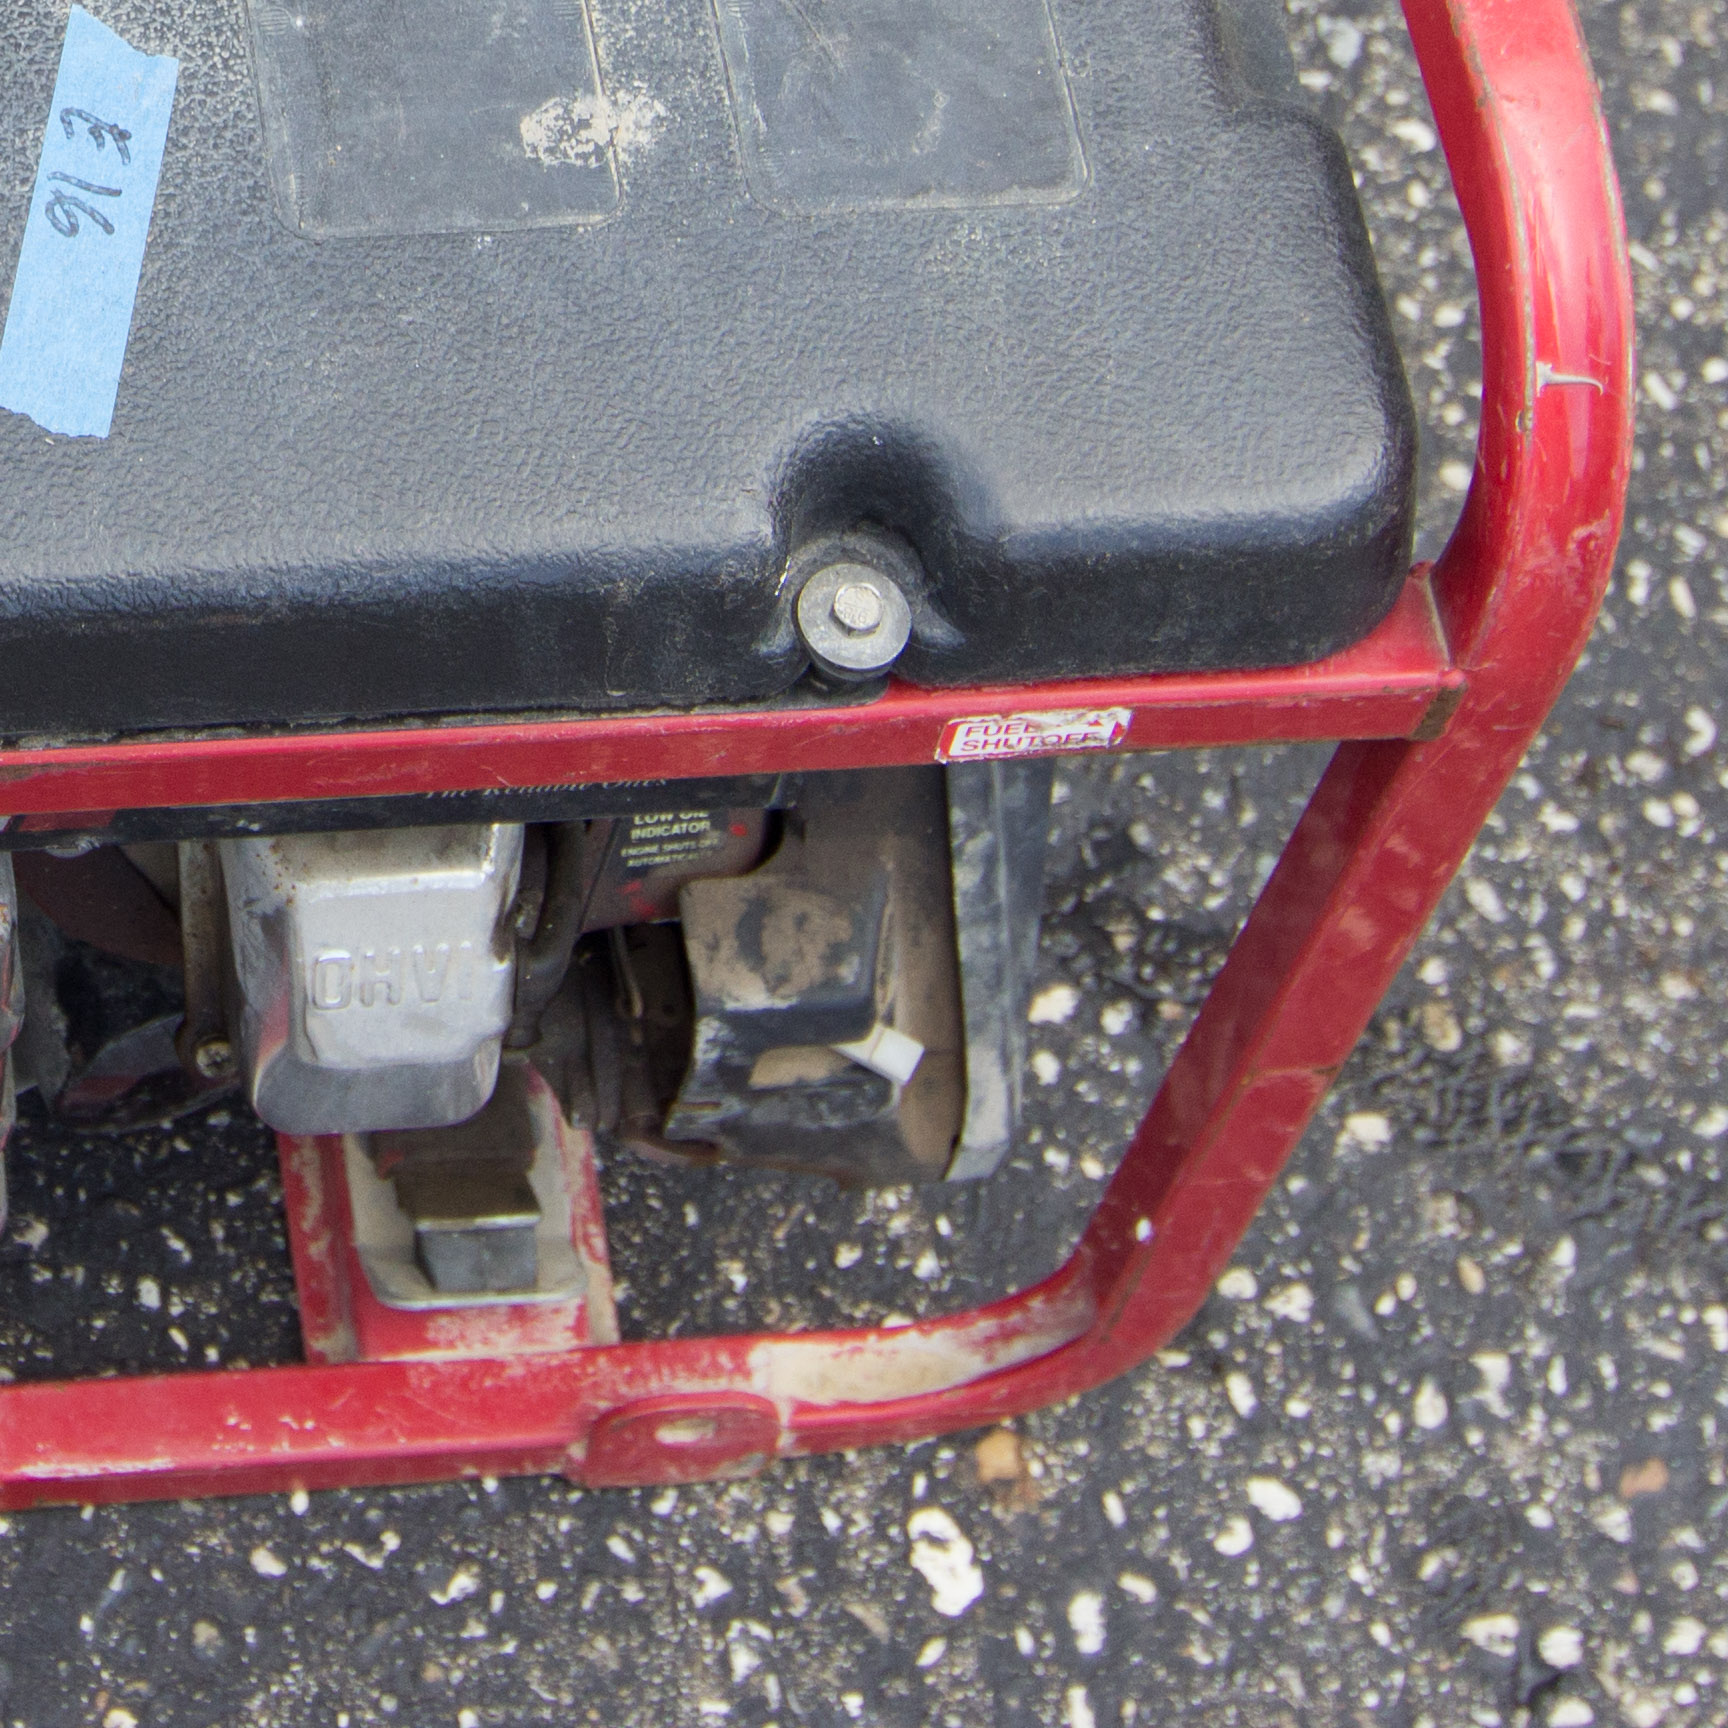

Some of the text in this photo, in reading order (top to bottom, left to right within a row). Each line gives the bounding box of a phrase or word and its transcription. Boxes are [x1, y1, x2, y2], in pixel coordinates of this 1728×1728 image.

[964, 722, 1037, 738] FUEL
[960, 731, 1100, 752] SHUTOFF
[630, 820, 711, 841] INDICATOR
